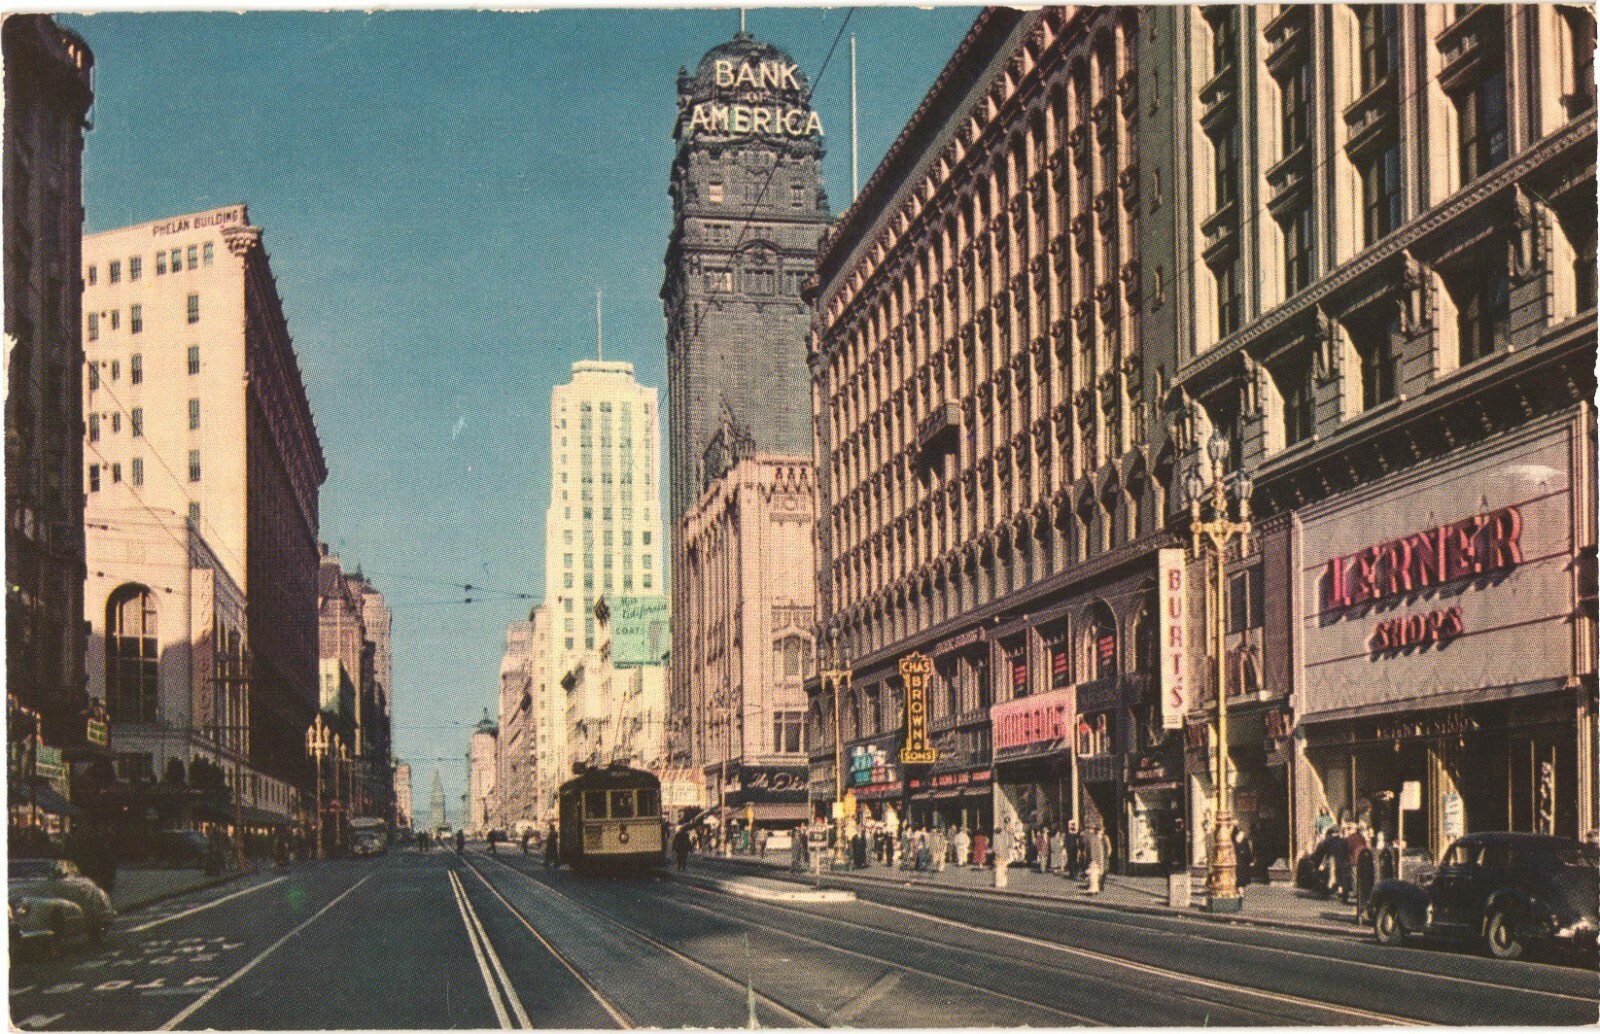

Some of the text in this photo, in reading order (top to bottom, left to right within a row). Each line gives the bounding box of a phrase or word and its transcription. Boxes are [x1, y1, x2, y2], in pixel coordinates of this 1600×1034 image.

[715, 60, 800, 91] BANK
[689, 104, 825, 137] AMERICA
[152, 209, 239, 237] PHELAN BUILDING
[1321, 505, 1523, 612] LERNER
[1167, 568, 1183, 708] BURT'S
[1371, 606, 1465, 651] SHOPS
[910, 675, 924, 740] BROWN
[903, 750, 932, 761] SONS
